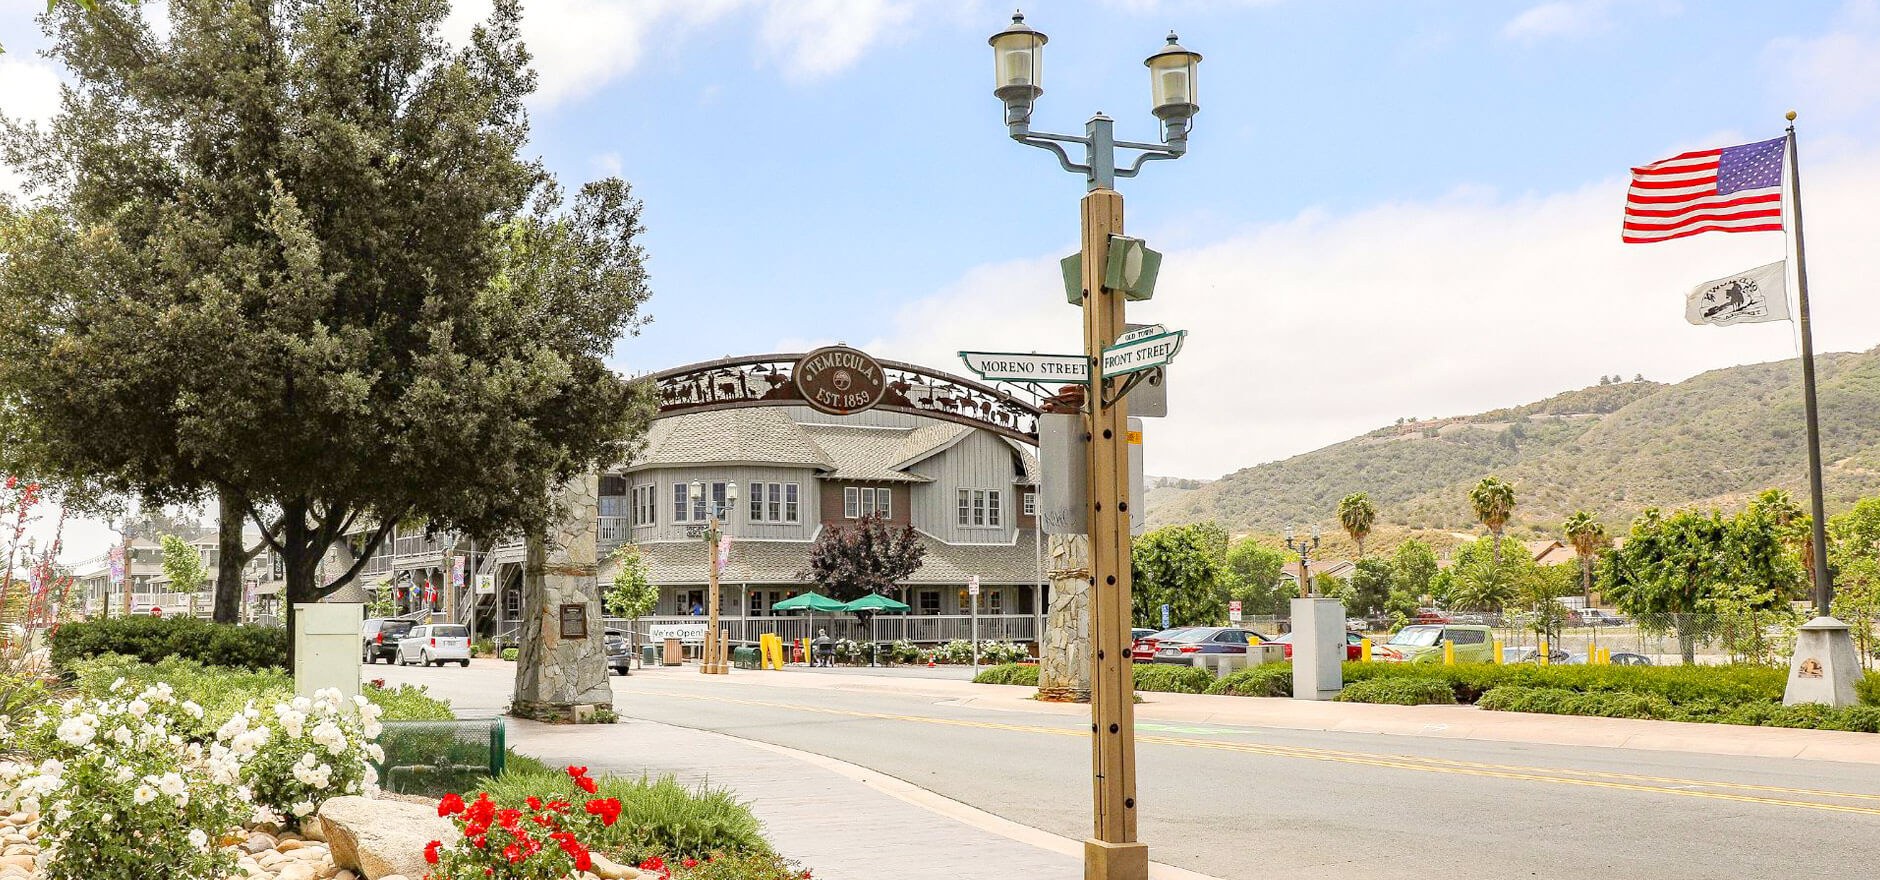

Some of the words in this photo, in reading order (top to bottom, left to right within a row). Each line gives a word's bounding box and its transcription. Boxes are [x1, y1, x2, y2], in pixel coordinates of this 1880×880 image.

[1138, 328, 1154, 338] TOWN
[1104, 352, 1132, 369] FRONT
[1136, 343, 1171, 361] STREET
[806, 353, 873, 380] TEMECULA
[981, 360, 1035, 373] MORENO
[1041, 362, 1087, 375] STREET
[816, 388, 841, 407] EST.
[843, 390, 870, 408] 1859
